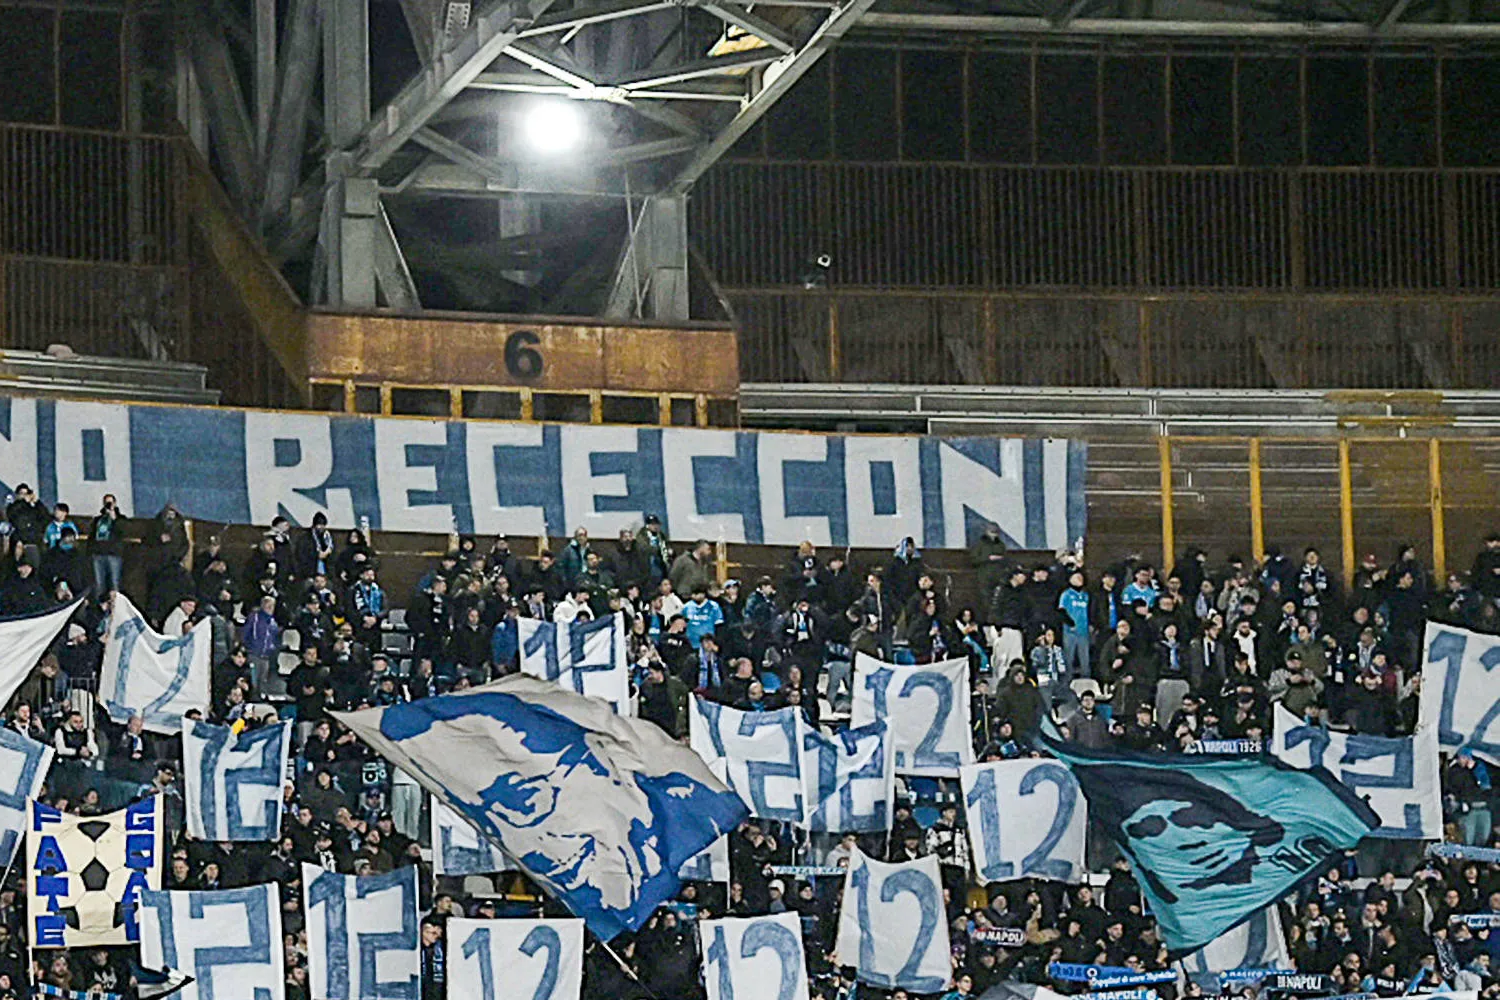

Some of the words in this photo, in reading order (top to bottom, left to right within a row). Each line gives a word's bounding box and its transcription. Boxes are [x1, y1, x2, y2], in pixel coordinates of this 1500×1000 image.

[504, 331, 543, 380] 6
[108, 616, 196, 729] 12
[190, 720, 287, 841] 12
[968, 765, 1075, 879] 12
[851, 862, 946, 993] 12
